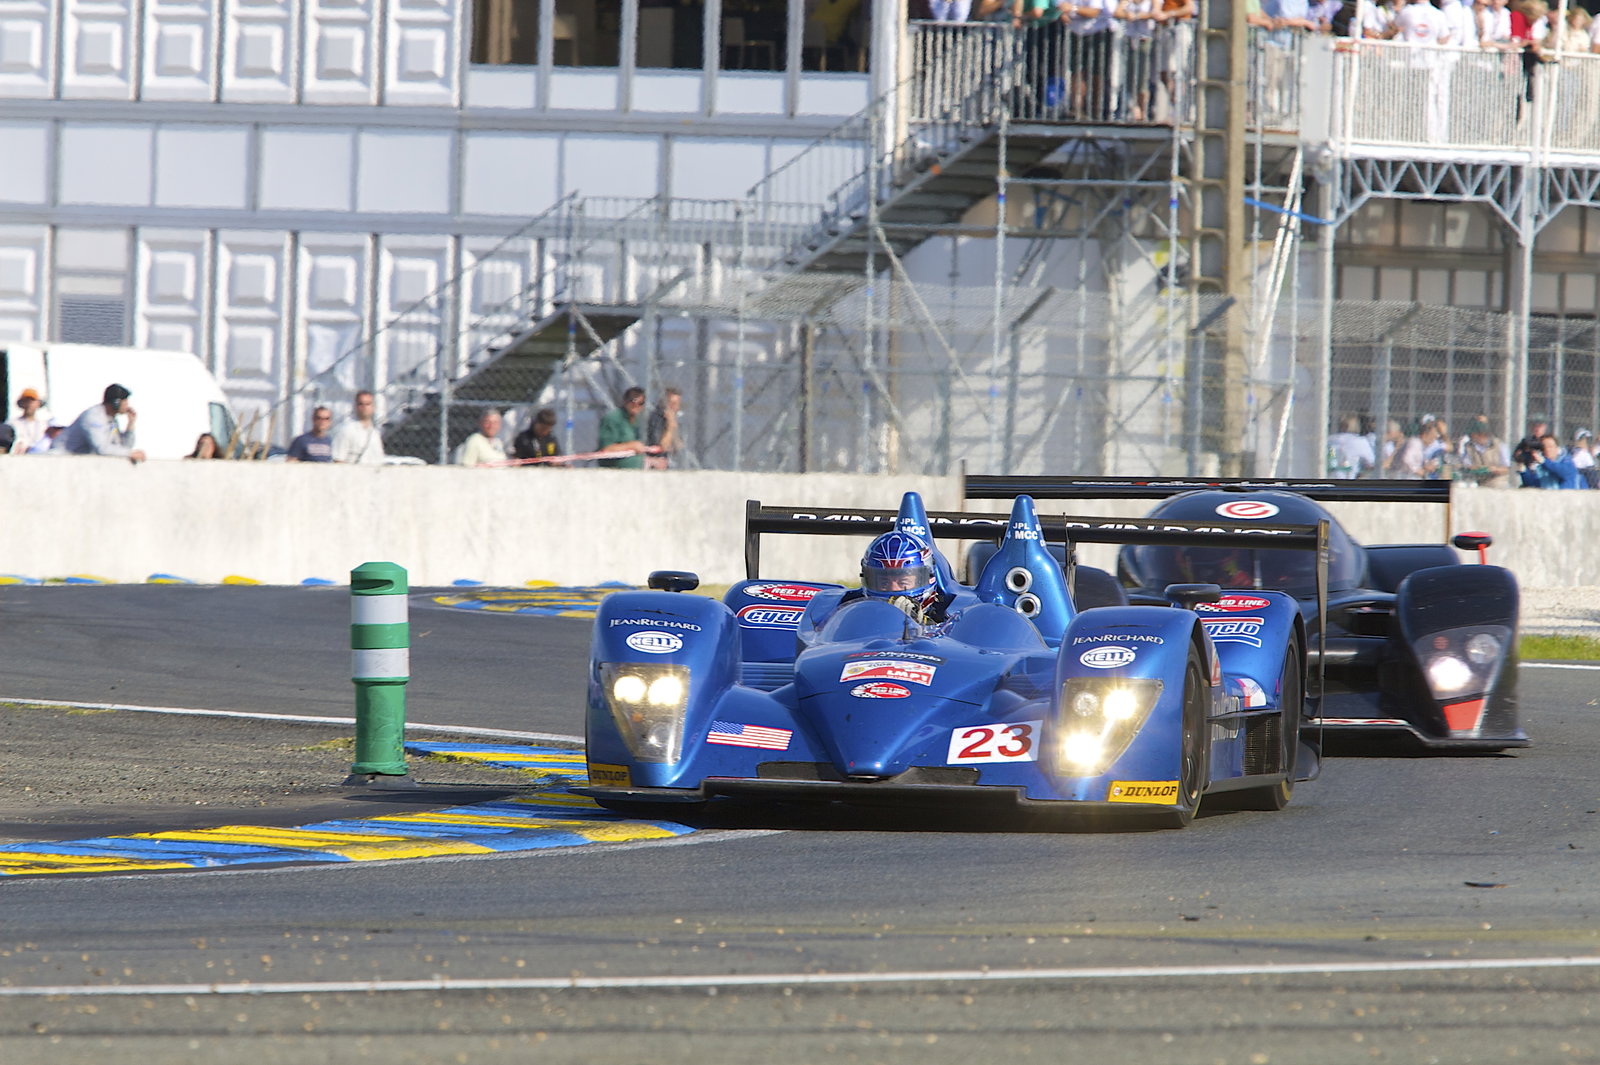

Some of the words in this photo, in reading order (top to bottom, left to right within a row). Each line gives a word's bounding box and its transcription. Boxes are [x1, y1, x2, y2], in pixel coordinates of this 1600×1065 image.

[899, 517, 917, 525] JPL
[1012, 522, 1030, 530] JPL
[1014, 530, 1038, 540] MCC
[747, 611, 804, 623] cycl
[1204, 621, 1261, 637] yclo
[630, 637, 683, 650] HELLA
[1084, 652, 1136, 662] HELLA
[957, 723, 1034, 759] 23
[1124, 786, 1177, 797] DUNLOP
